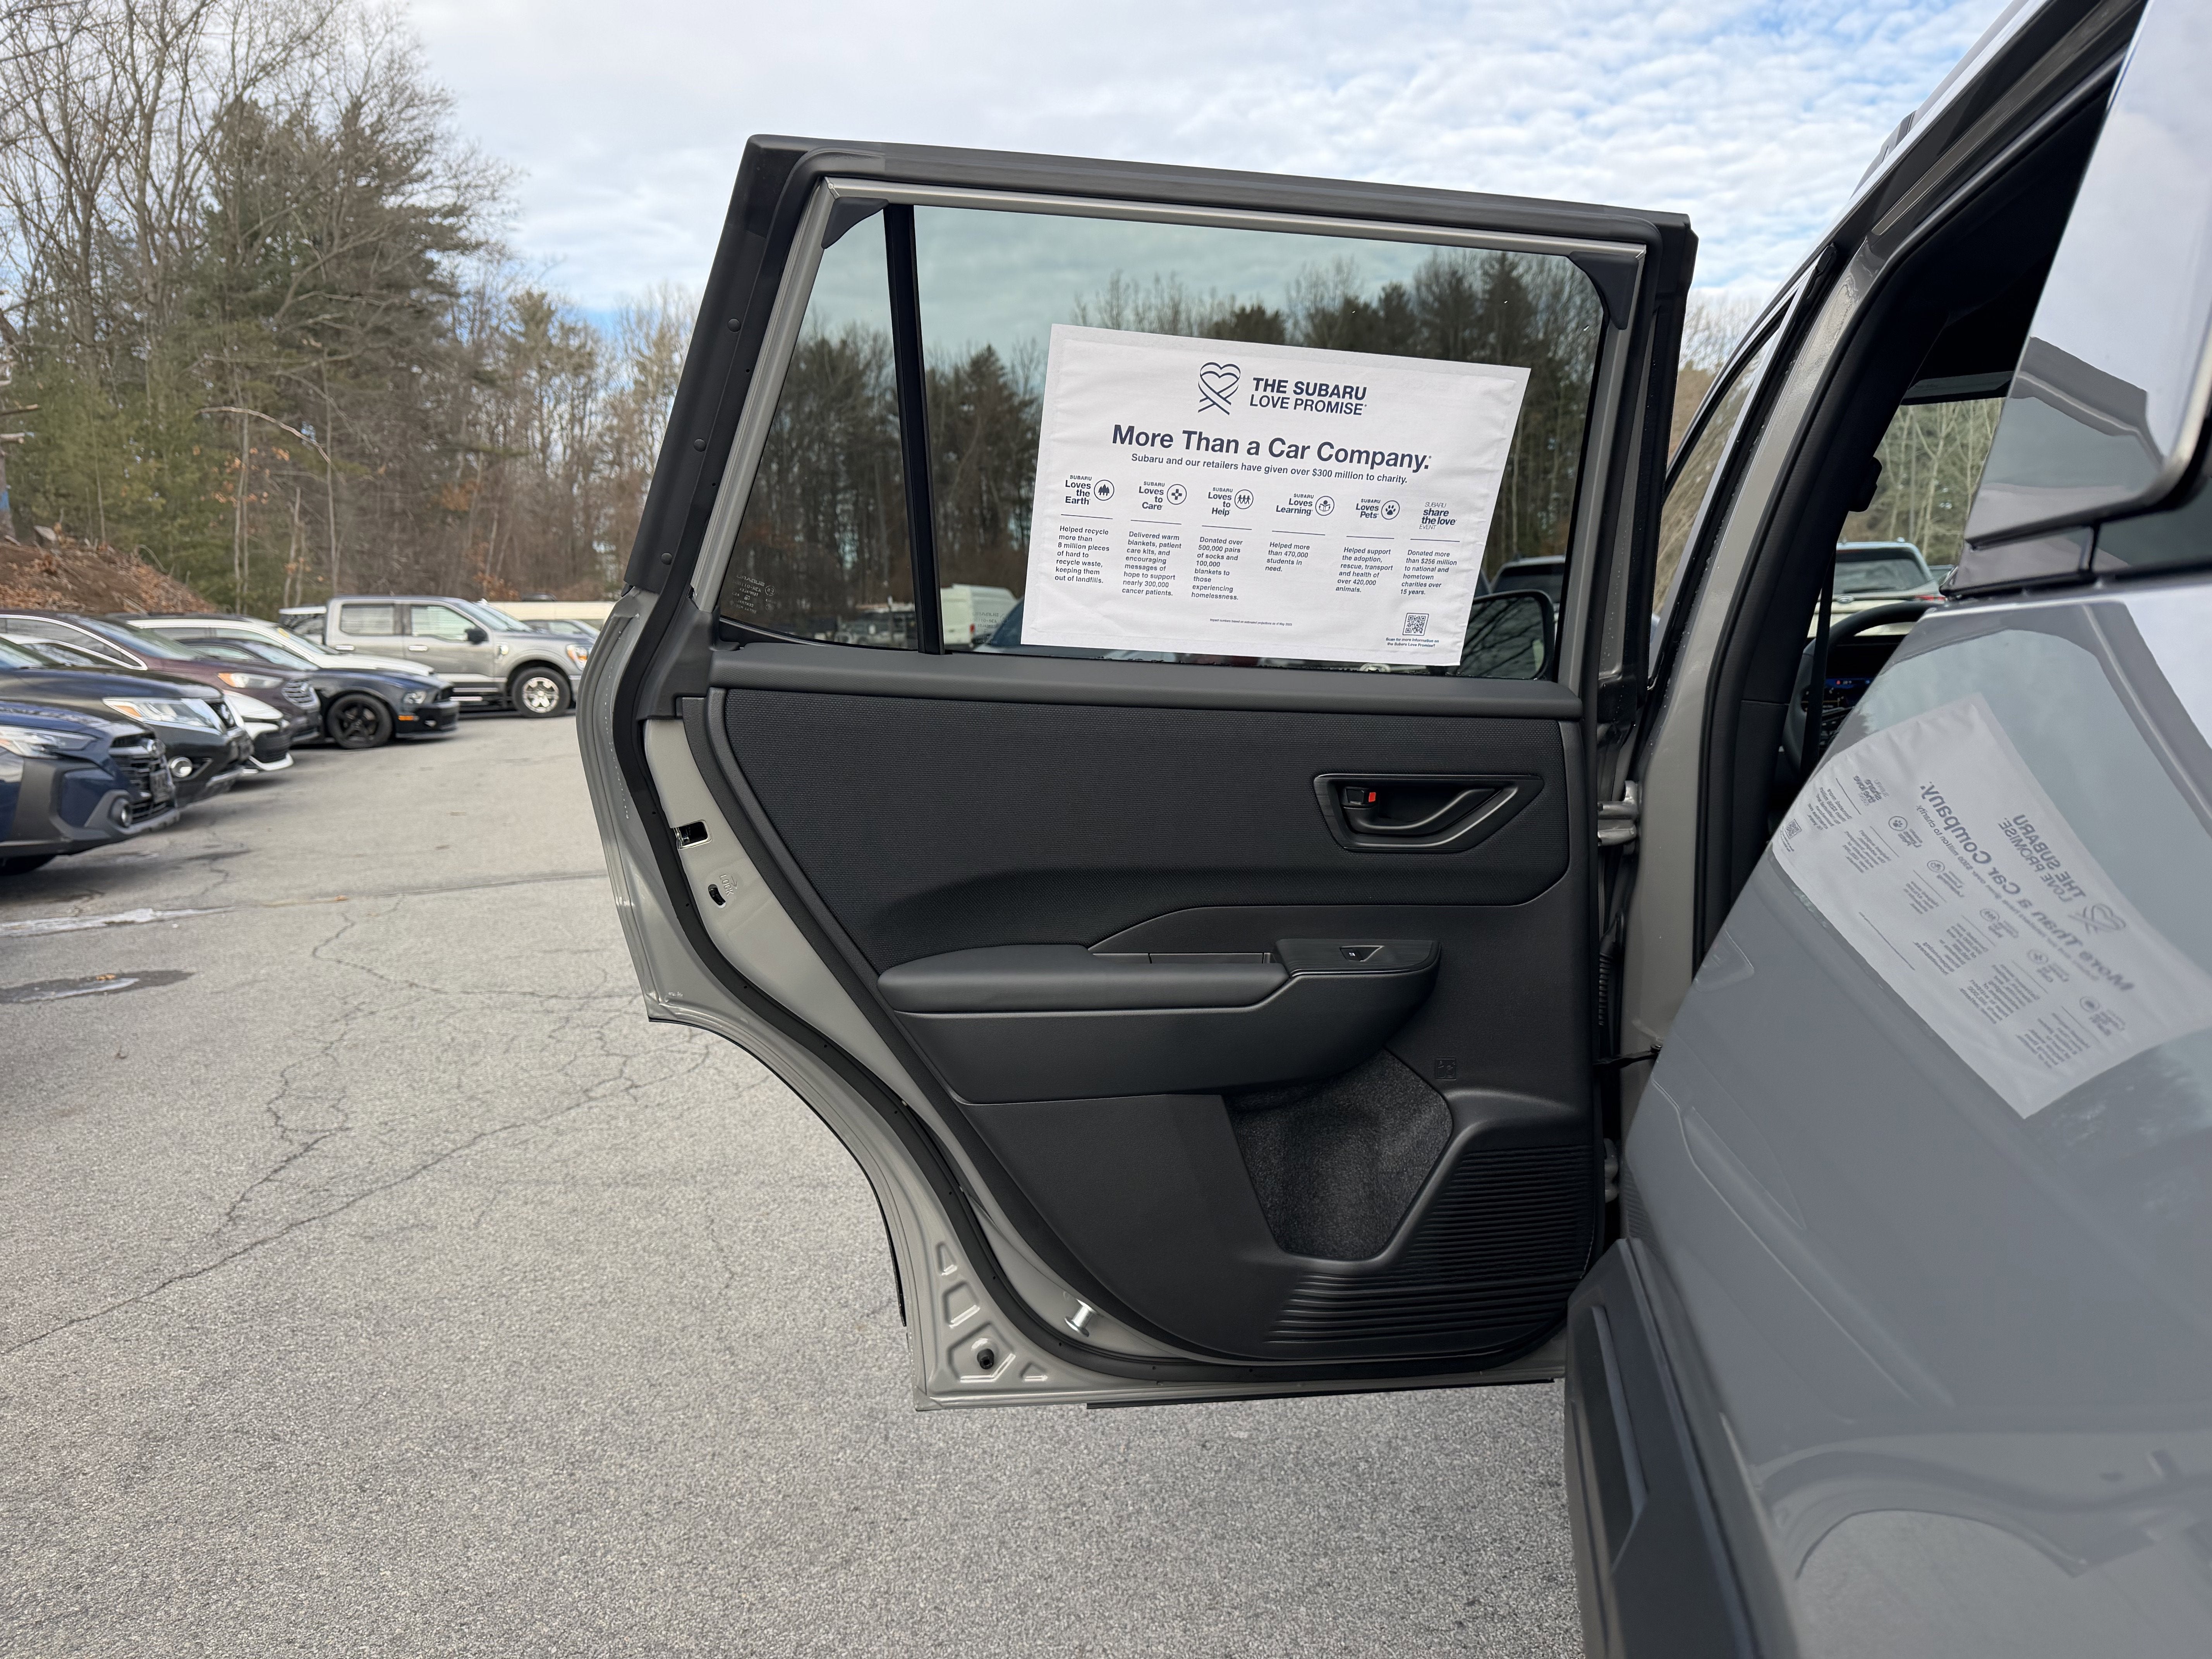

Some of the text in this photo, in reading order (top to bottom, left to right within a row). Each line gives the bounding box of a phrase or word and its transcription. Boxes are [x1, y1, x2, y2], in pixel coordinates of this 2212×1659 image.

[1253, 377, 1367, 401] THE SUBARU
[1250, 394, 1290, 409] LOVE
[1112, 424, 1174, 448] More
[1182, 430, 1239, 454] Than
[1247, 441, 1260, 456] a
[1268, 437, 1311, 459] Car
[1131, 453, 1164, 464] Subaru
[1202, 460, 1238, 470] retailers
[1241, 462, 1262, 472] have
[1264, 465, 1288, 474] given
[1312, 468, 1333, 477] $300
[1334, 471, 1364, 480] million
[1366, 473, 1374, 481] to
[1377, 474, 1407, 485] charity.
[1065, 479, 1091, 489] Loves
[1076, 489, 1090, 497] the
[1139, 486, 1164, 495] Loves
[1208, 491, 1232, 501] Loves
[1288, 498, 1313, 507] Loves
[1355, 503, 1379, 512] Loves
[1423, 508, 1449, 517] share
[1421, 516, 1436, 525] the
[1060, 525, 1083, 534] Helped
[1129, 531, 1160, 539] Delivered
[1128, 539, 1157, 548] blankets,
[1269, 541, 1292, 550] Helped
[1125, 556, 1167, 565] encouraging
[1055, 566, 1082, 575] keeping
[1192, 584, 1233, 593] experiencing
[1191, 591, 1238, 600] homelessness.
[720, 874, 734, 896] LOCK
